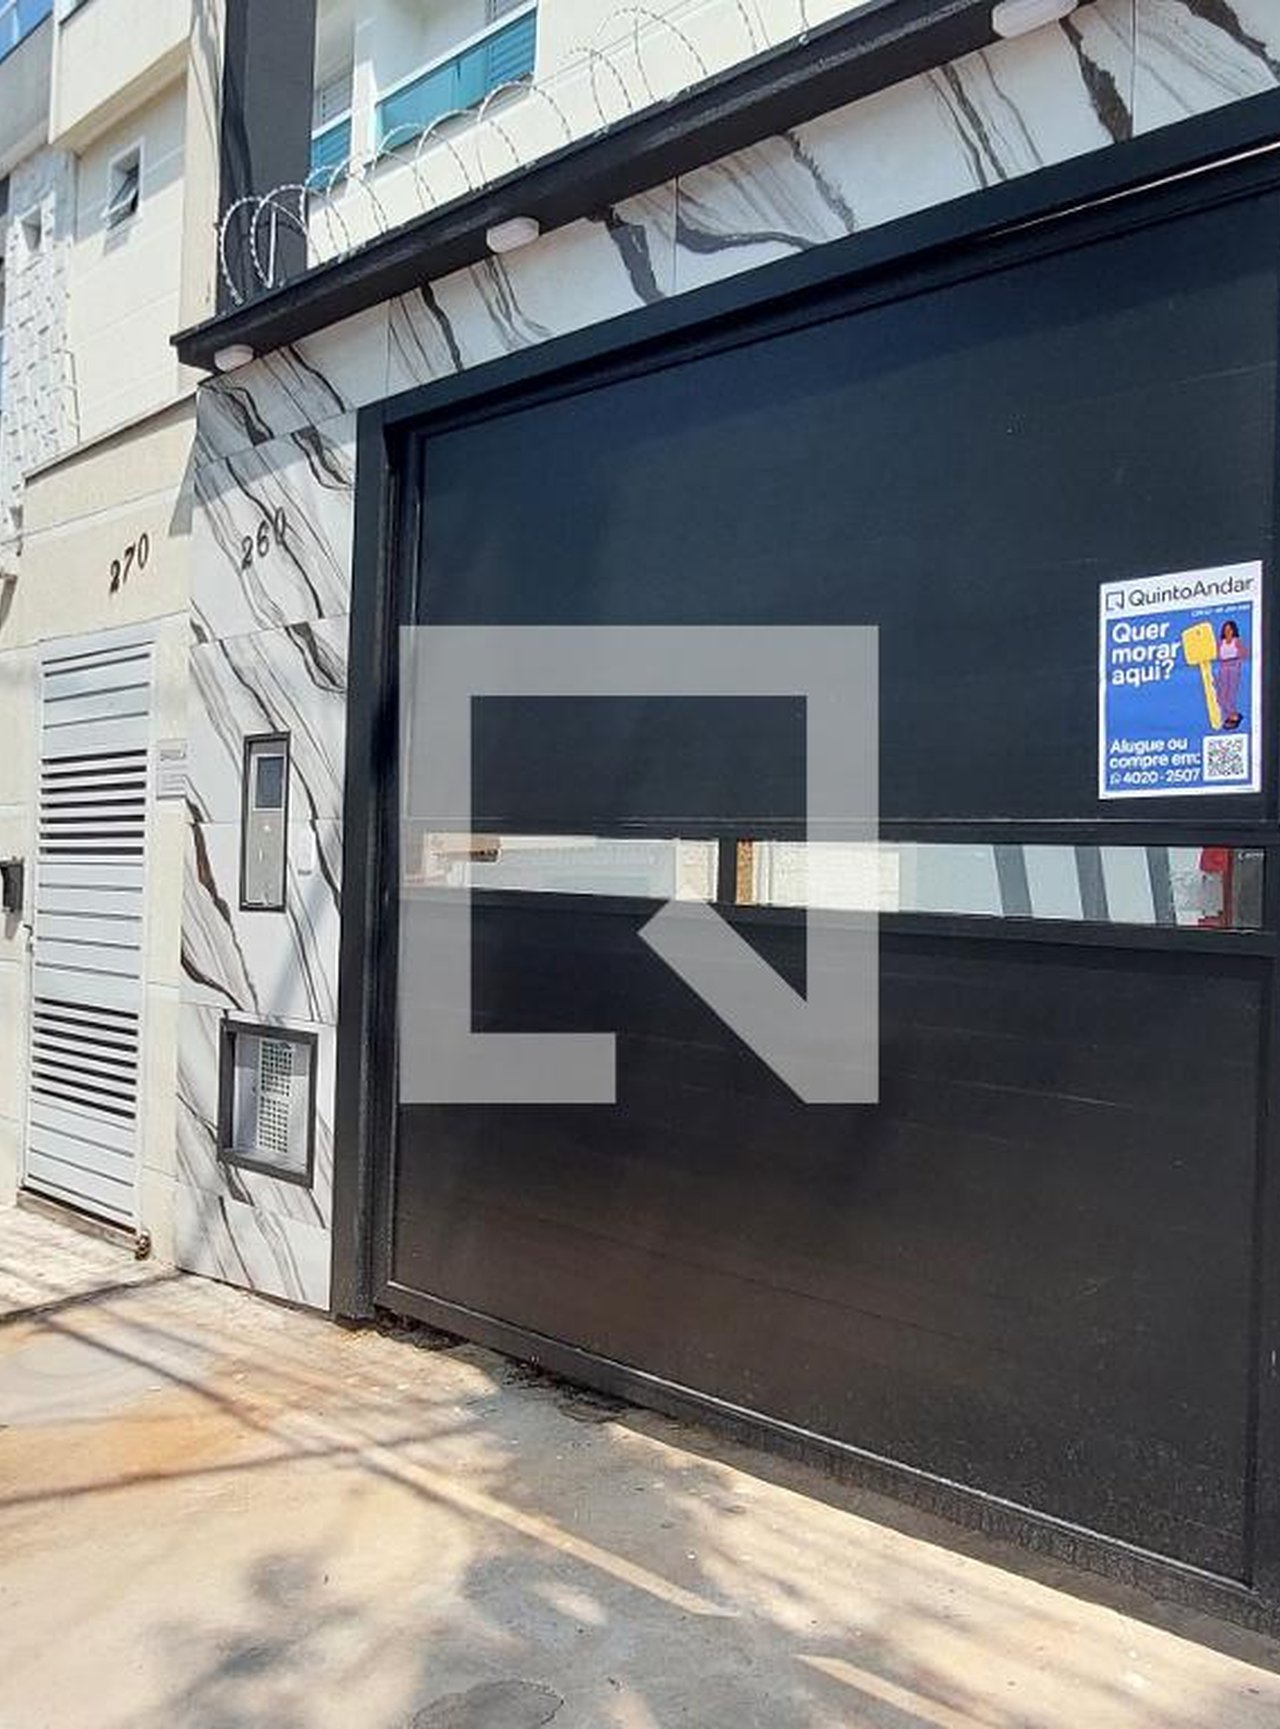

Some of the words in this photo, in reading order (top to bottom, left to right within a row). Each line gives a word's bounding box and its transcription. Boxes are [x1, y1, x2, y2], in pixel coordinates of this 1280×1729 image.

[241, 506, 286, 570] 260
[109, 532, 150, 594] 270
[1128, 576, 1254, 607] QuintoAndar
[1112, 622, 1169, 643] Quer
[1112, 641, 1181, 665] morar
[1112, 659, 1174, 688] aqui?
[1110, 738, 1165, 755] Alugue
[1167, 738, 1188, 750] ou
[1109, 754, 1169, 769] compre
[1172, 752, 1201, 766] em:
